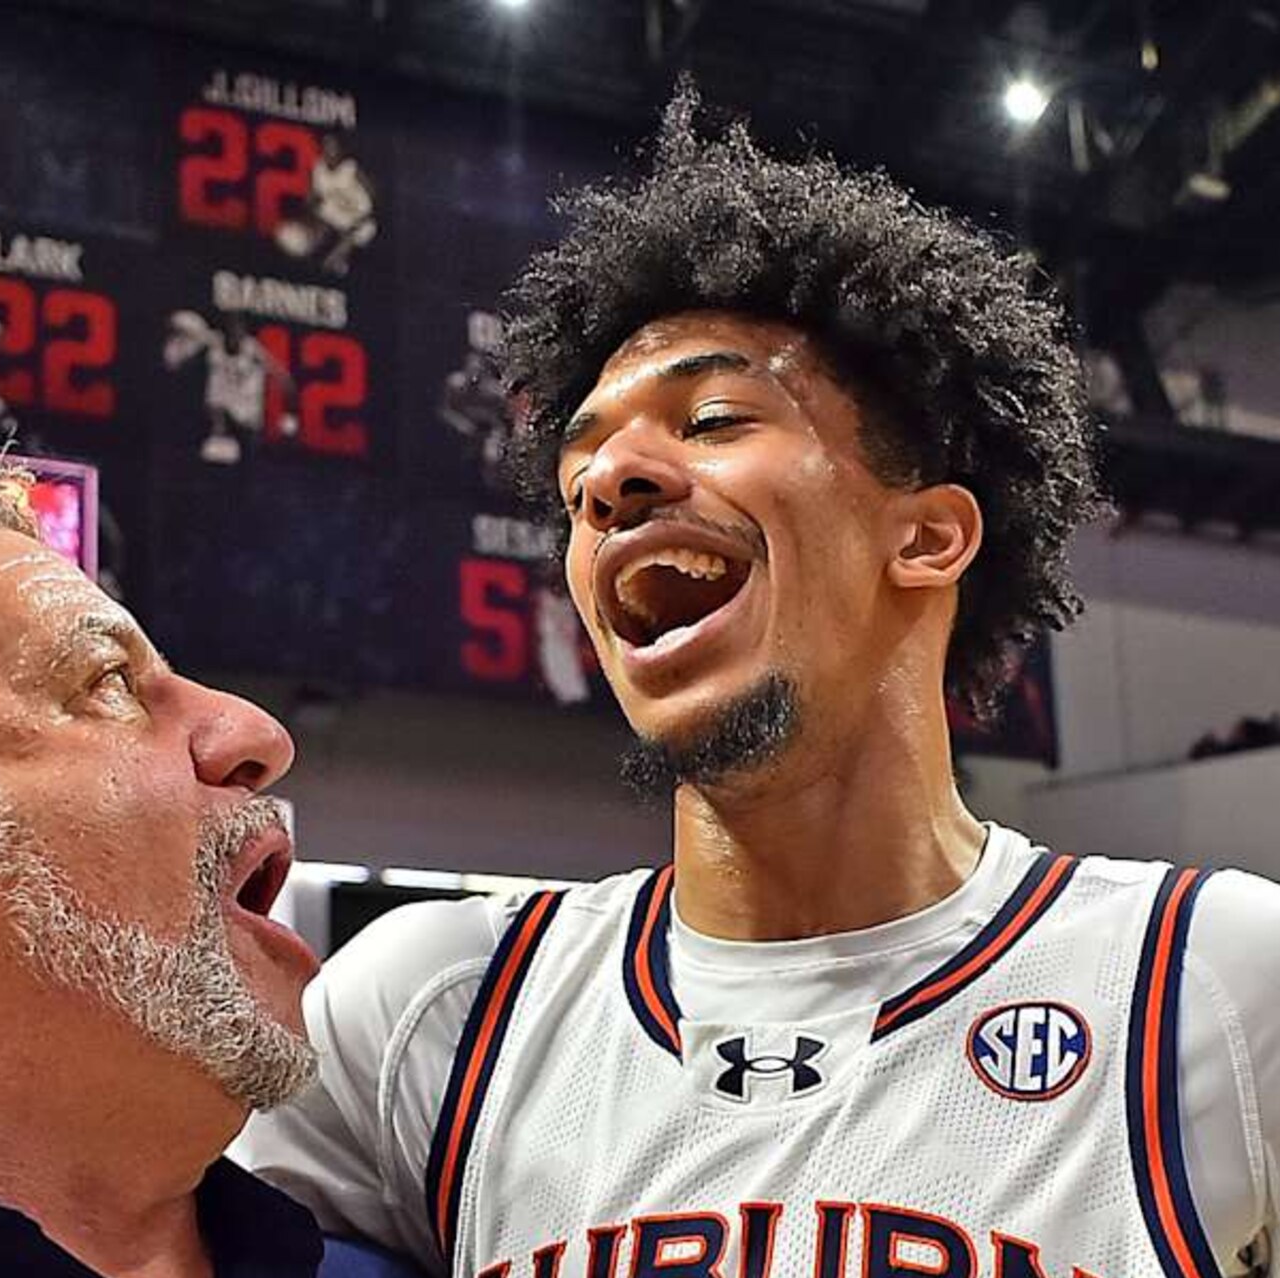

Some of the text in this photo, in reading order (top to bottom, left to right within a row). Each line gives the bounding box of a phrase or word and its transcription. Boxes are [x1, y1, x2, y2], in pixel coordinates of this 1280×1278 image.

[179, 107, 320, 238] 22
[213, 268, 348, 329] BARNES
[257, 323, 368, 456] 12
[978, 1008, 1080, 1094] SEC
